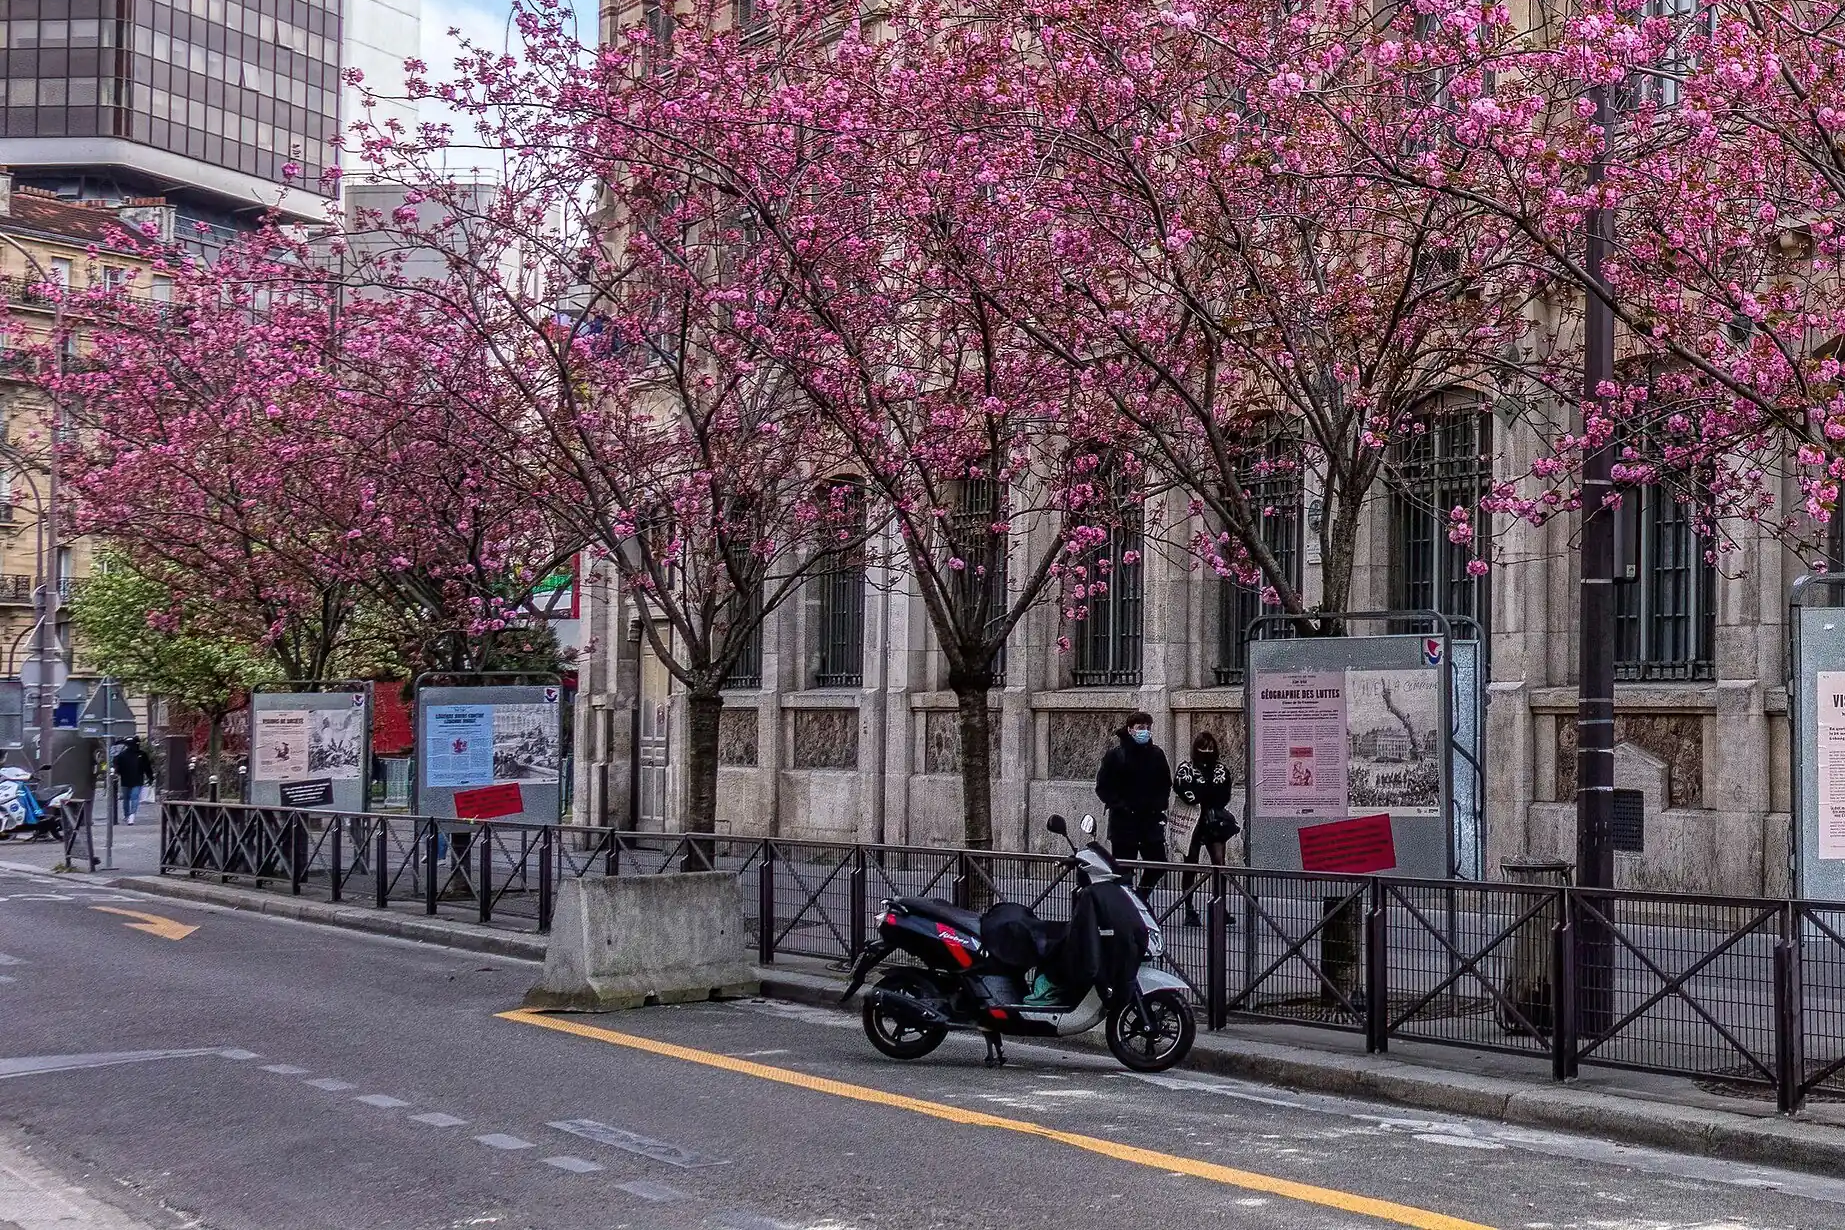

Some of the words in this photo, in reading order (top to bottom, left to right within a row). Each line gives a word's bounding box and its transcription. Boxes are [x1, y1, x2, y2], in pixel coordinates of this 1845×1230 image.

[1261, 689, 1300, 699] GÉOGRAPHIE
[1302, 690, 1315, 699] DES
[1316, 689, 1340, 698] LUTTES
